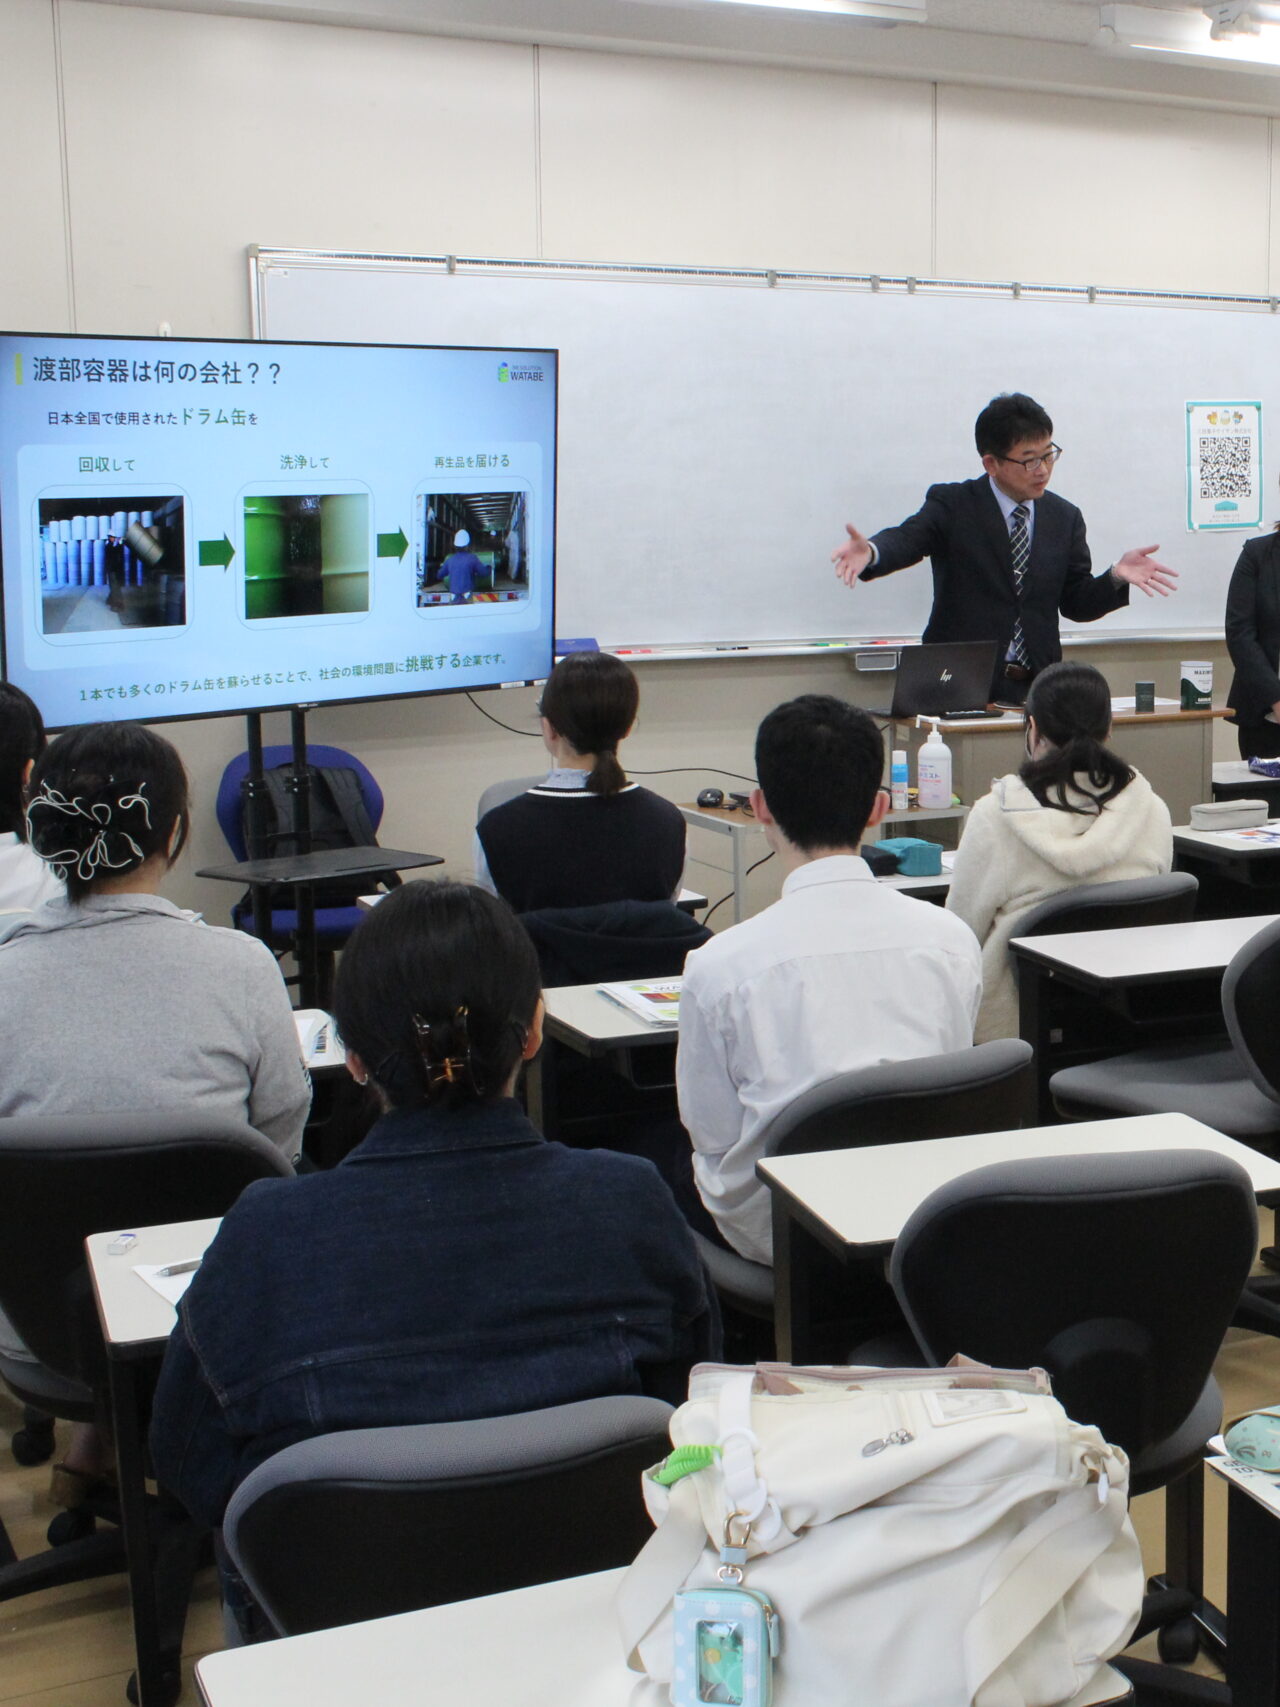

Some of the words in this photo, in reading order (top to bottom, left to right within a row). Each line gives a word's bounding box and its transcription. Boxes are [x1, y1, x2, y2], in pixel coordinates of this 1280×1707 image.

[33, 356, 281, 384] 渡部容器は何の会社？？
[510, 371, 544, 382] WATABE
[48, 407, 258, 425] 日本全国で使用されたドラム缶を
[79, 456, 136, 473] 回収して
[280, 455, 329, 470] 洗浄して
[434, 454, 510, 468] 再生品を届ける
[940, 668, 953, 682] hp
